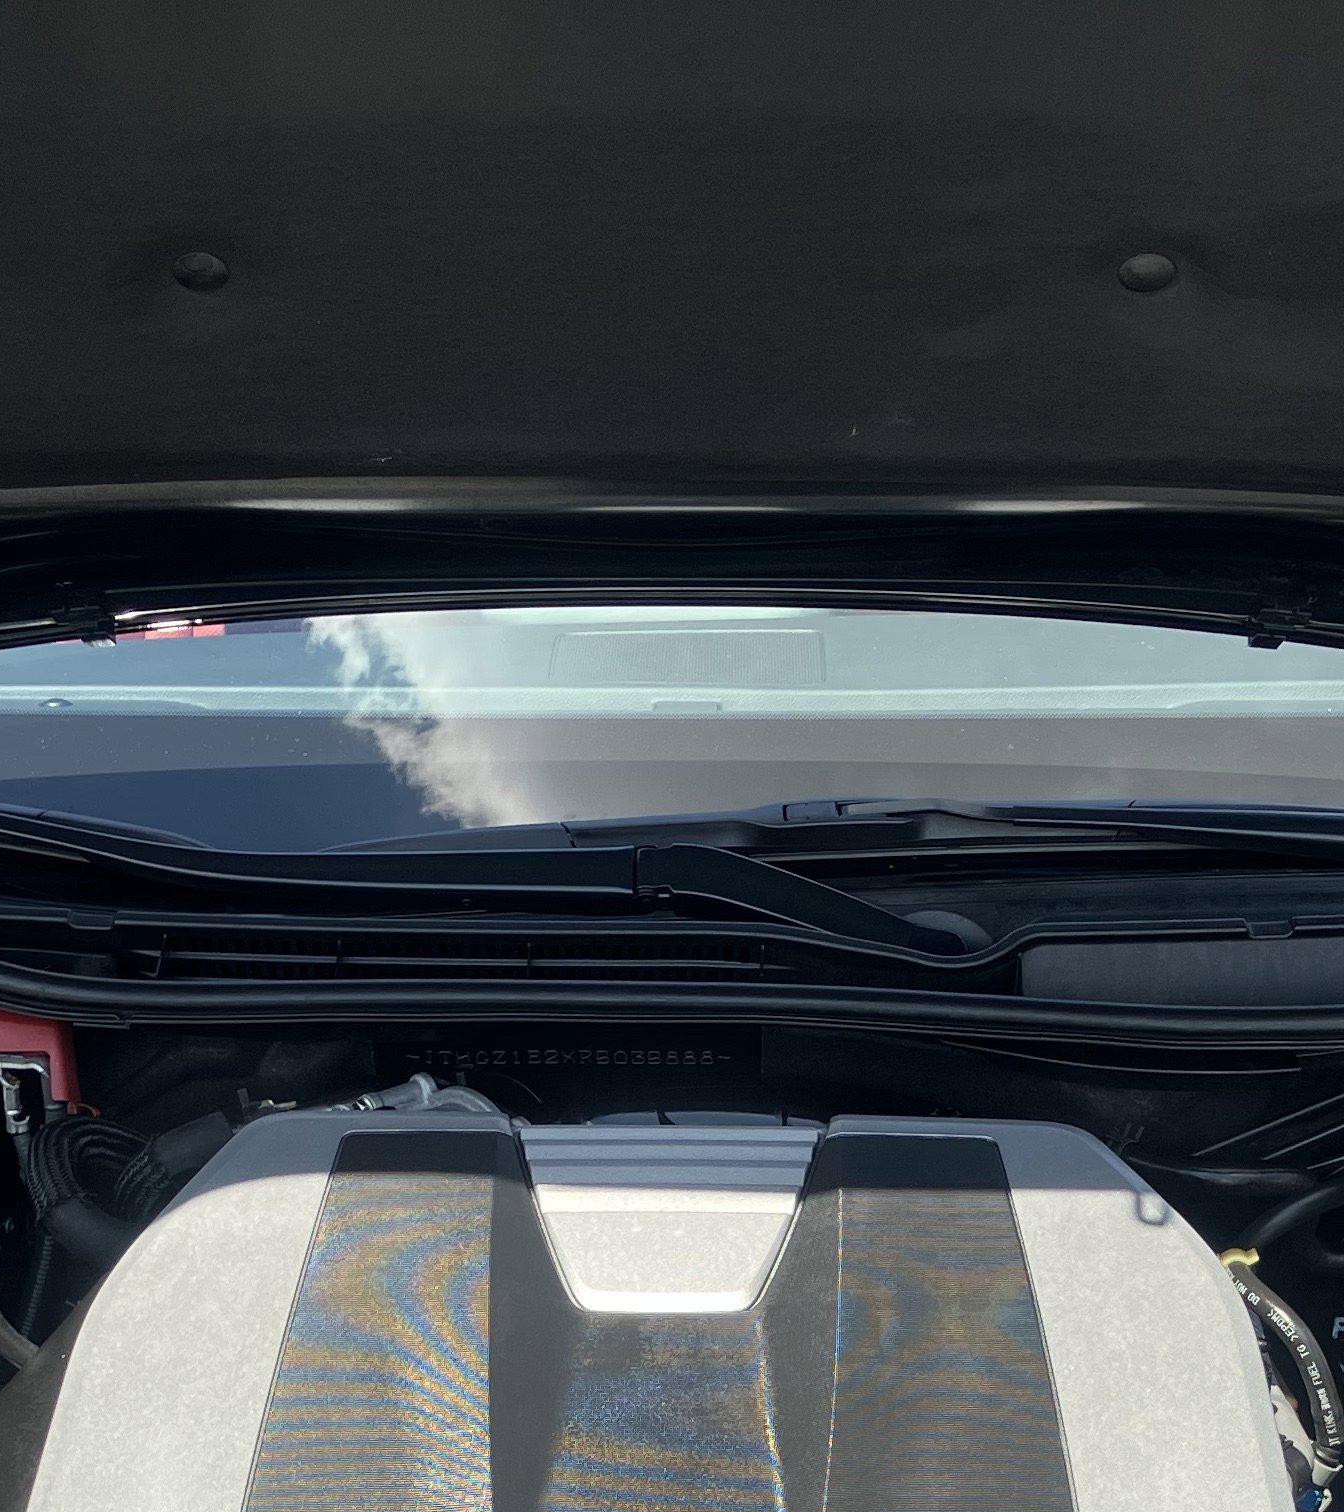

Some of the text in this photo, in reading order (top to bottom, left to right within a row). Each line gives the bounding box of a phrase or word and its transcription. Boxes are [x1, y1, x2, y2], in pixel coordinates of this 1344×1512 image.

[1247, 1291, 1261, 1306] DO
[1296, 1343, 1310, 1359] TG
[1307, 1360, 1323, 1386] FUEL
